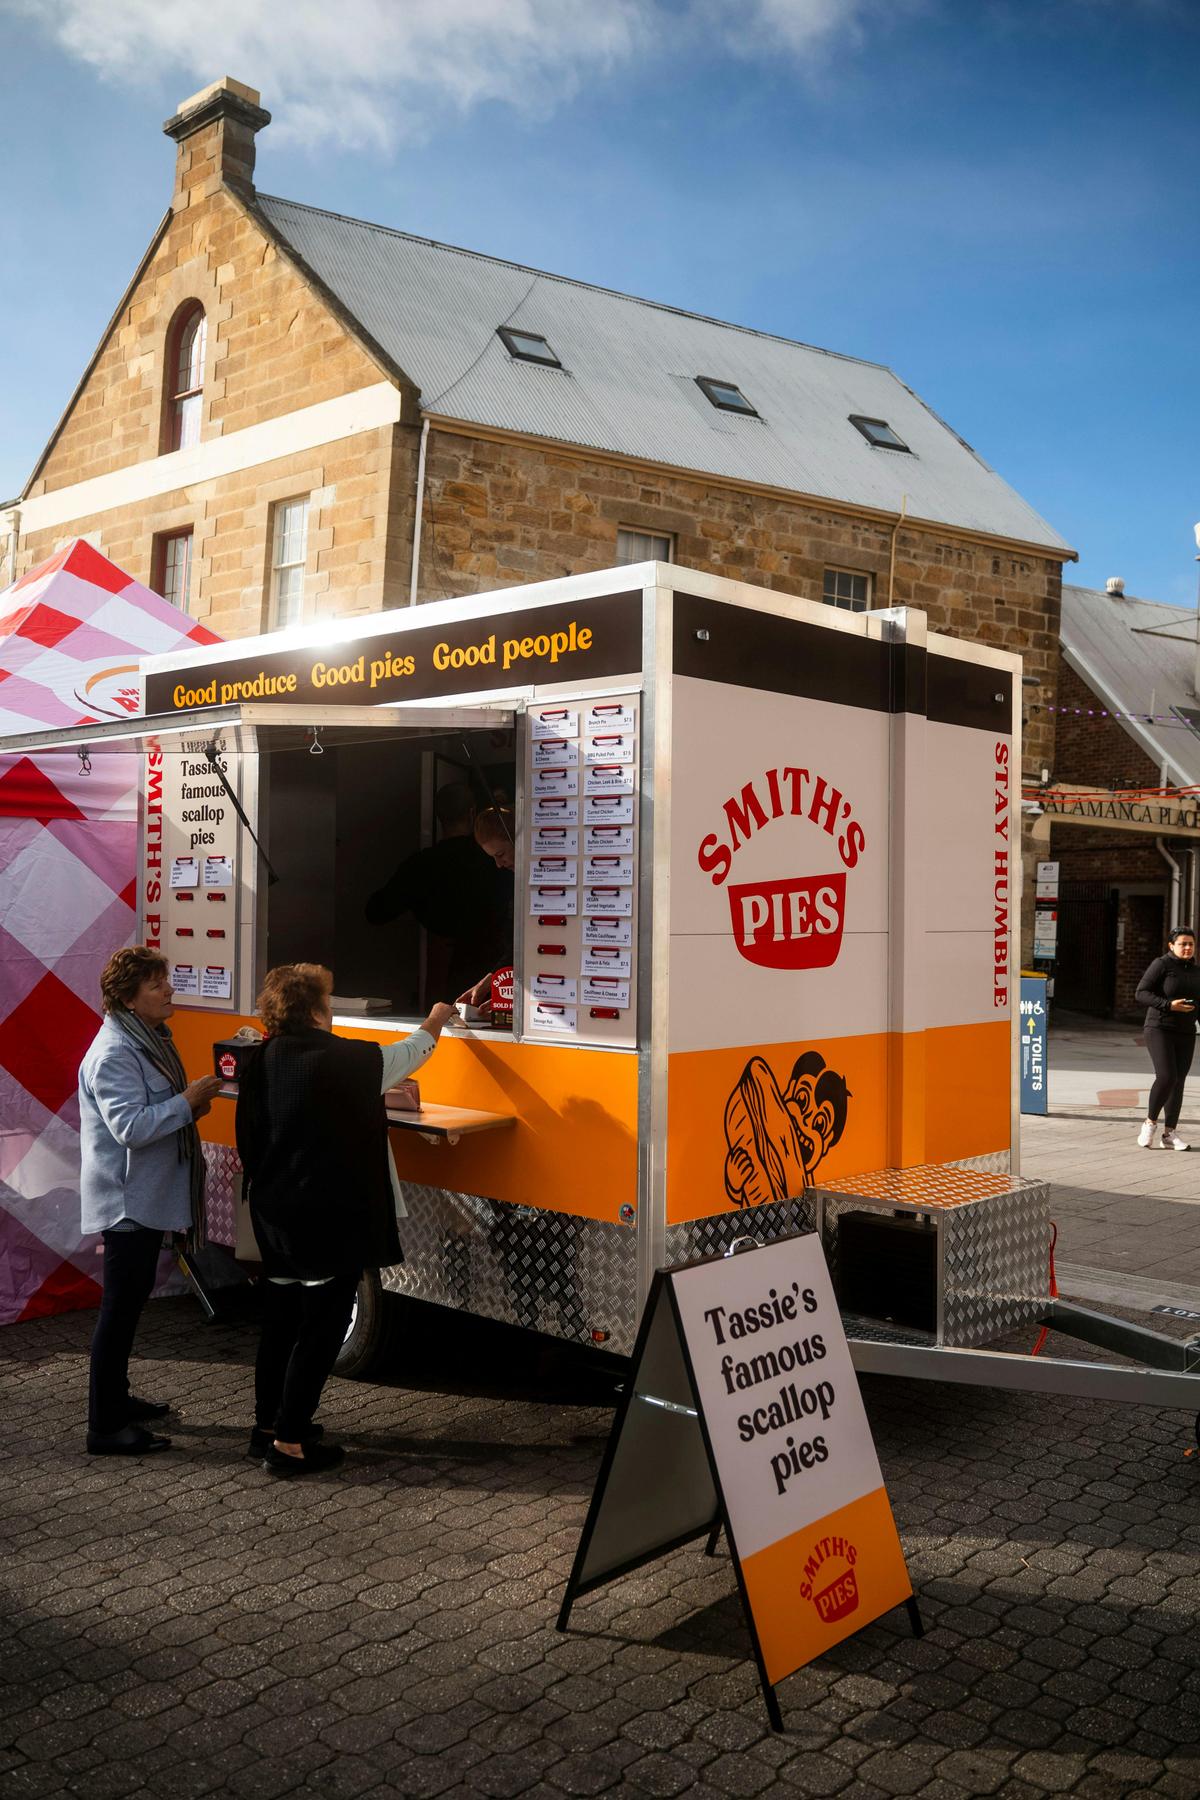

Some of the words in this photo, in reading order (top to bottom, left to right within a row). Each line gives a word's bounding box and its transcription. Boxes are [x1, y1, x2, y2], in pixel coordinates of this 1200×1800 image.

[311, 656, 365, 688] Good
[370, 651, 416, 688] pies
[432, 634, 496, 671] Good
[502, 621, 593, 670] people
[173, 679, 217, 708] Good
[220, 671, 297, 706] produce
[181, 783, 226, 800] famous
[182, 804, 224, 825] scallop
[994, 741, 1009, 841] STAY
[146, 752, 163, 904] SMITH'S
[190, 828, 215, 850] pies
[697, 766, 866, 886] SMITH'S
[145, 914, 161, 949] PI
[740, 886, 840, 947] PIES
[993, 850, 1009, 1008] HUMBLE
[493, 970, 514, 987] SMIT
[501, 987, 514, 996] PIE
[1031, 1035, 1043, 1091] TOILETS
[704, 1281, 818, 1345] Tassie's
[720, 1331, 827, 1395] famous
[737, 1380, 836, 1443] scallop
[770, 1435, 829, 1495] pies
[800, 1536, 858, 1601] SMITH'S
[818, 1577, 856, 1618] PIES
